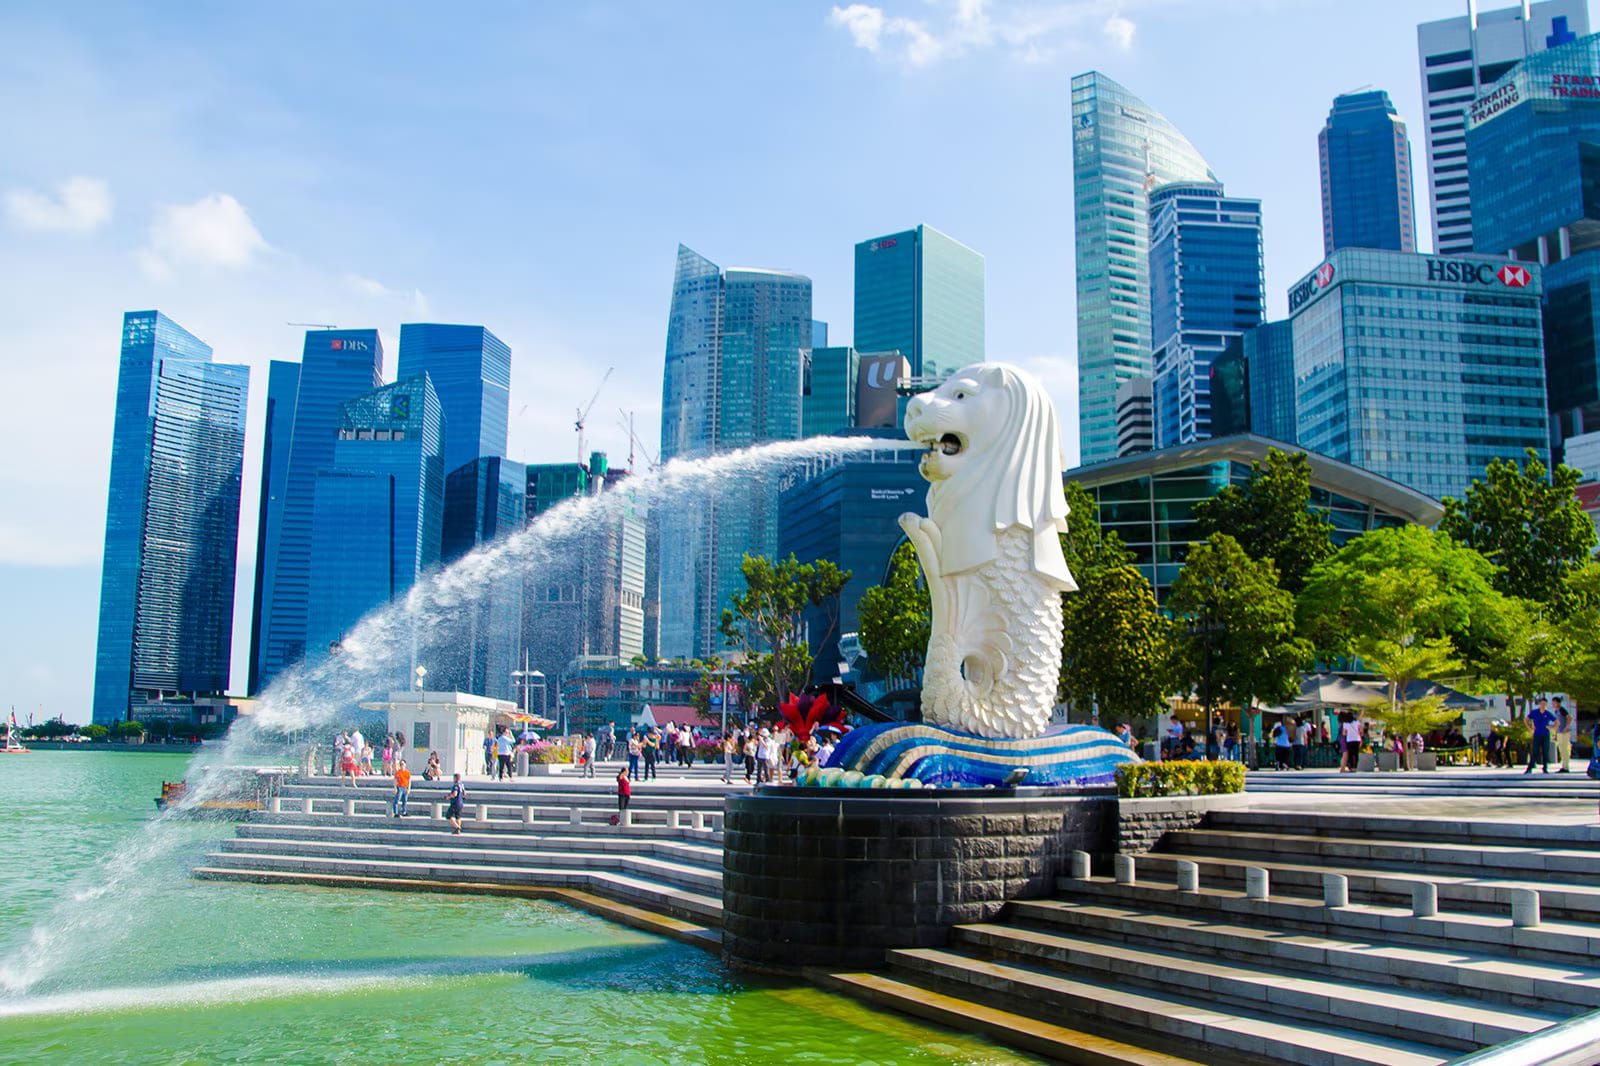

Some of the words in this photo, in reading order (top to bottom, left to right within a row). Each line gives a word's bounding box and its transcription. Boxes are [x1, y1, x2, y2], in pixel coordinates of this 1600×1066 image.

[1470, 82, 1516, 112] STRAITS
[1471, 92, 1519, 124] TRADING
[1426, 259, 1493, 285] HSBC
[1288, 272, 1318, 313] HSBC
[343, 339, 368, 351] DBS
